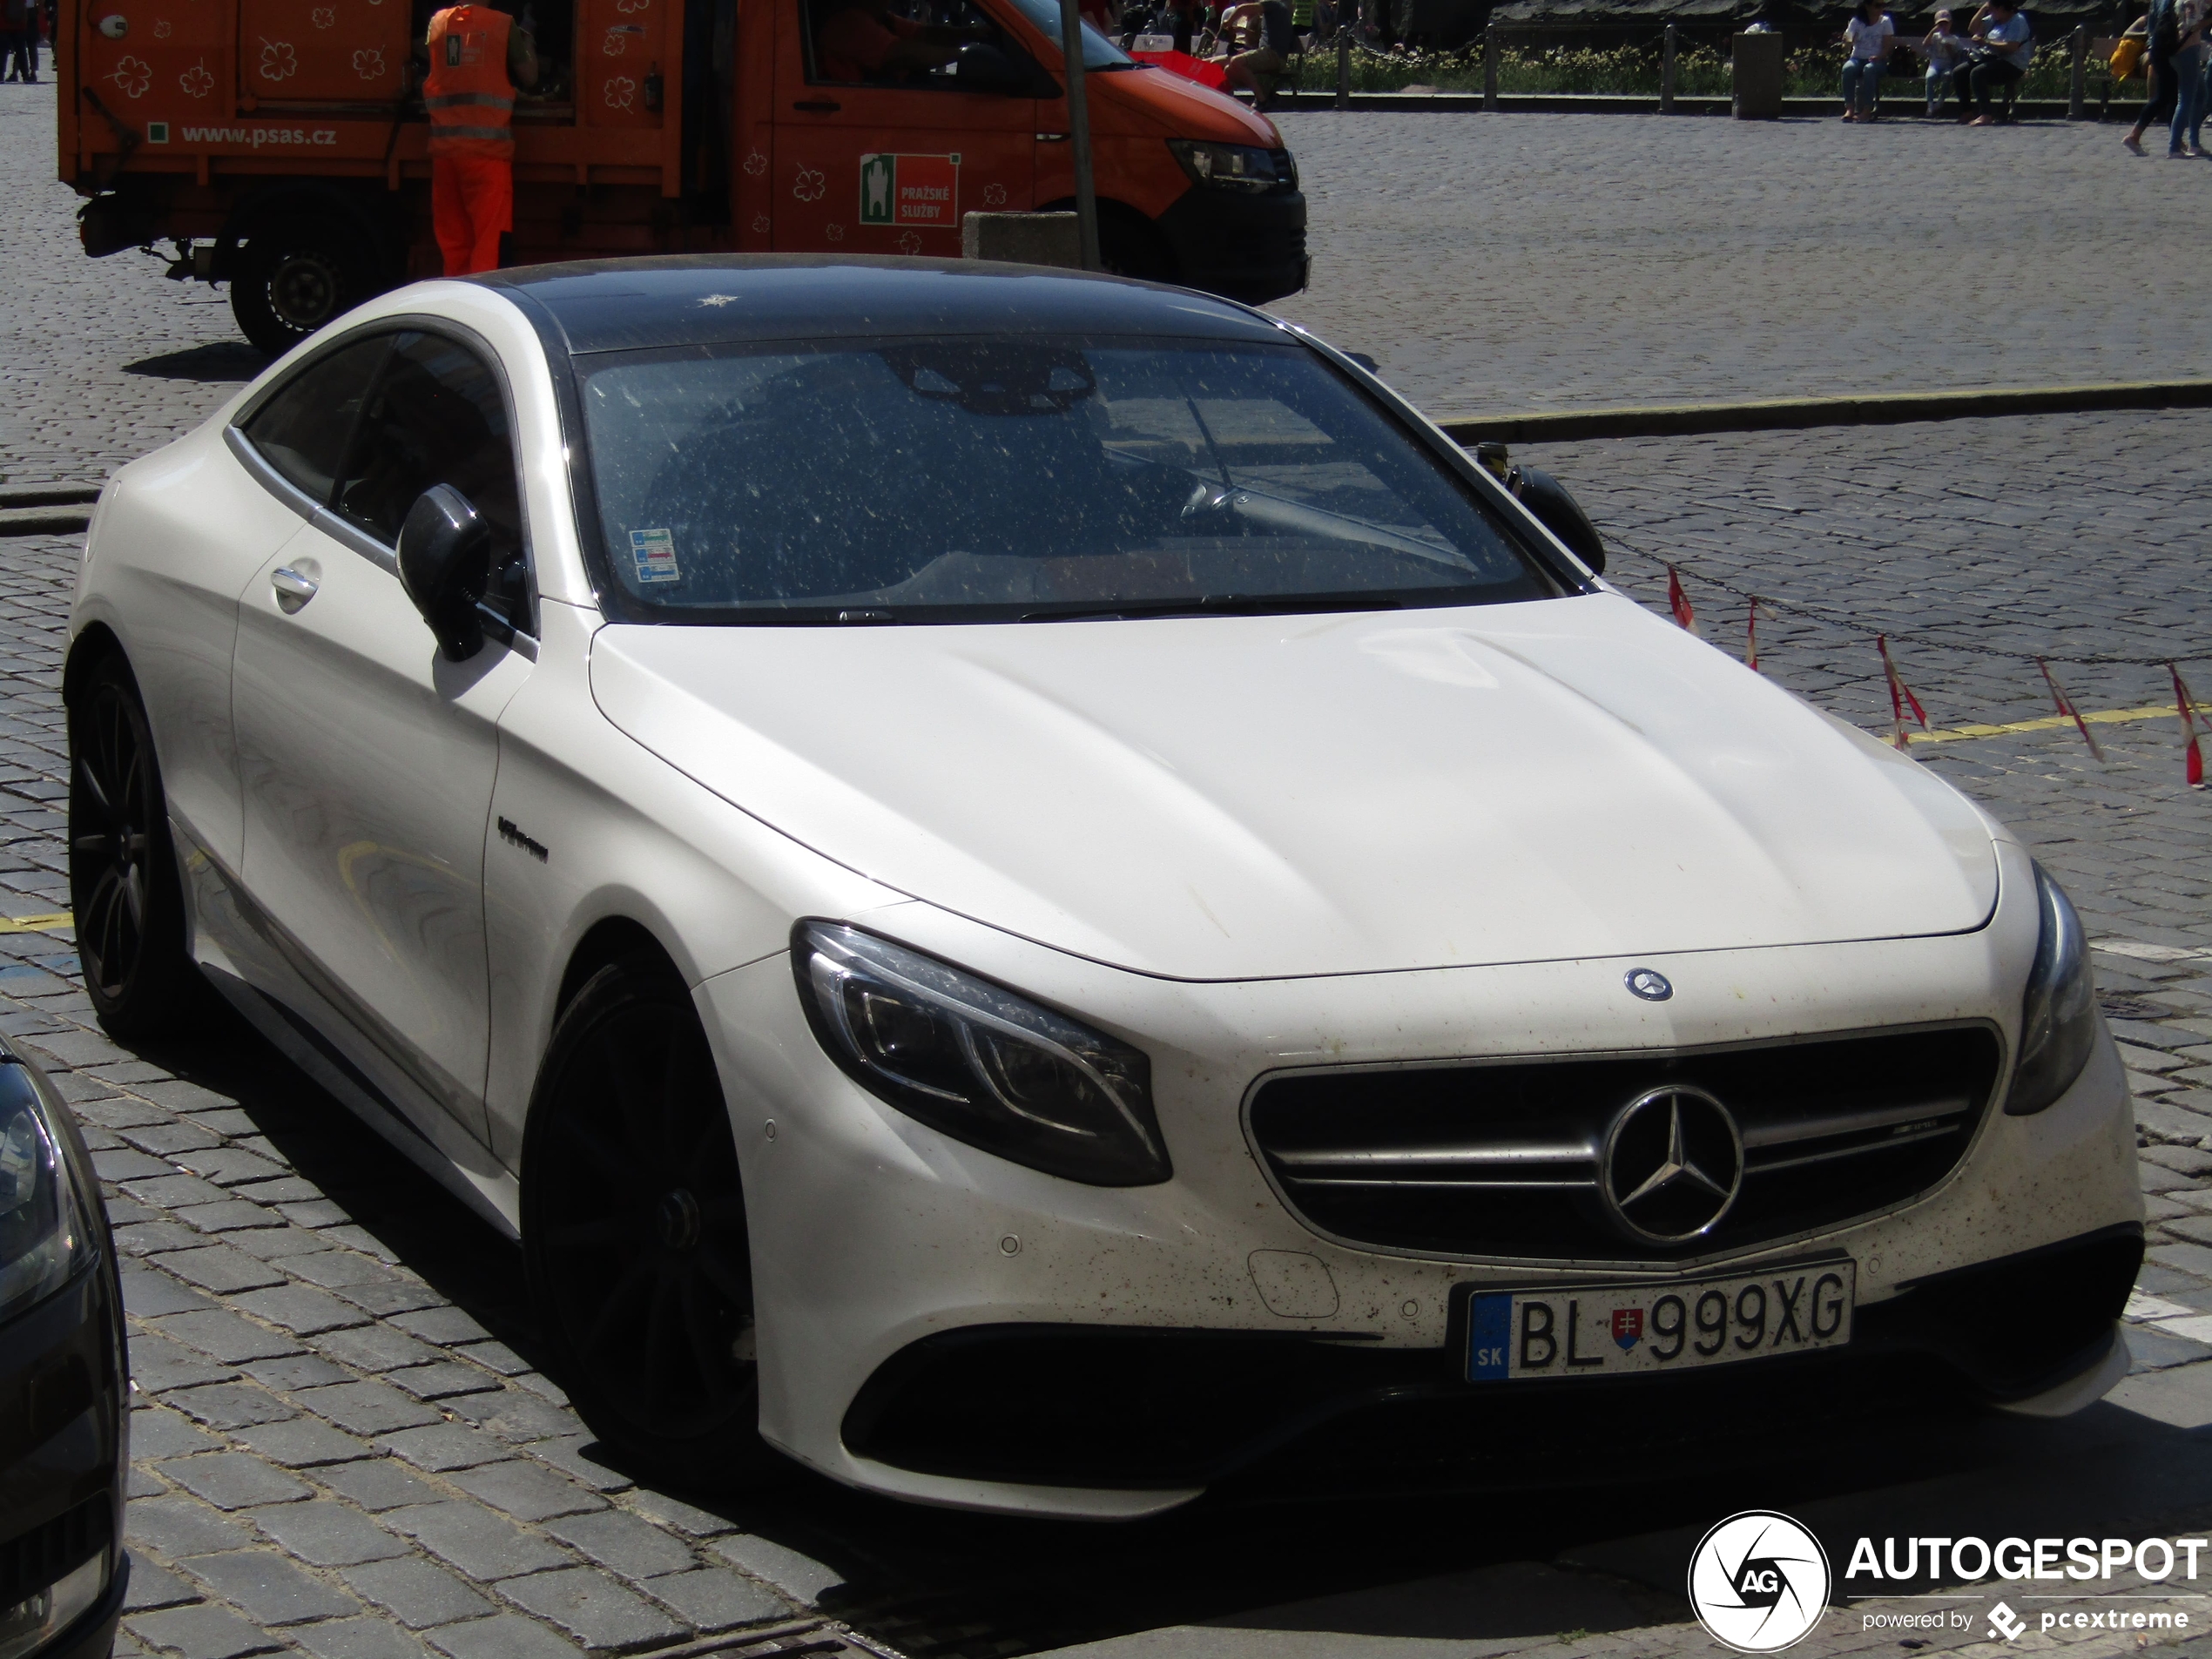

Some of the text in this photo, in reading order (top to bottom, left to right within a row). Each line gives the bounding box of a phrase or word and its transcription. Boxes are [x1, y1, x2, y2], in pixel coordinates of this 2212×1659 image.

[182, 127, 337, 149] www.psas.cz
[901, 185, 950, 201] PRAŽSKÉ
[901, 203, 941, 219] SLUŽBY
[1520, 1271, 1844, 1370] BL 999XG
[1477, 1346, 1503, 1367] SK
